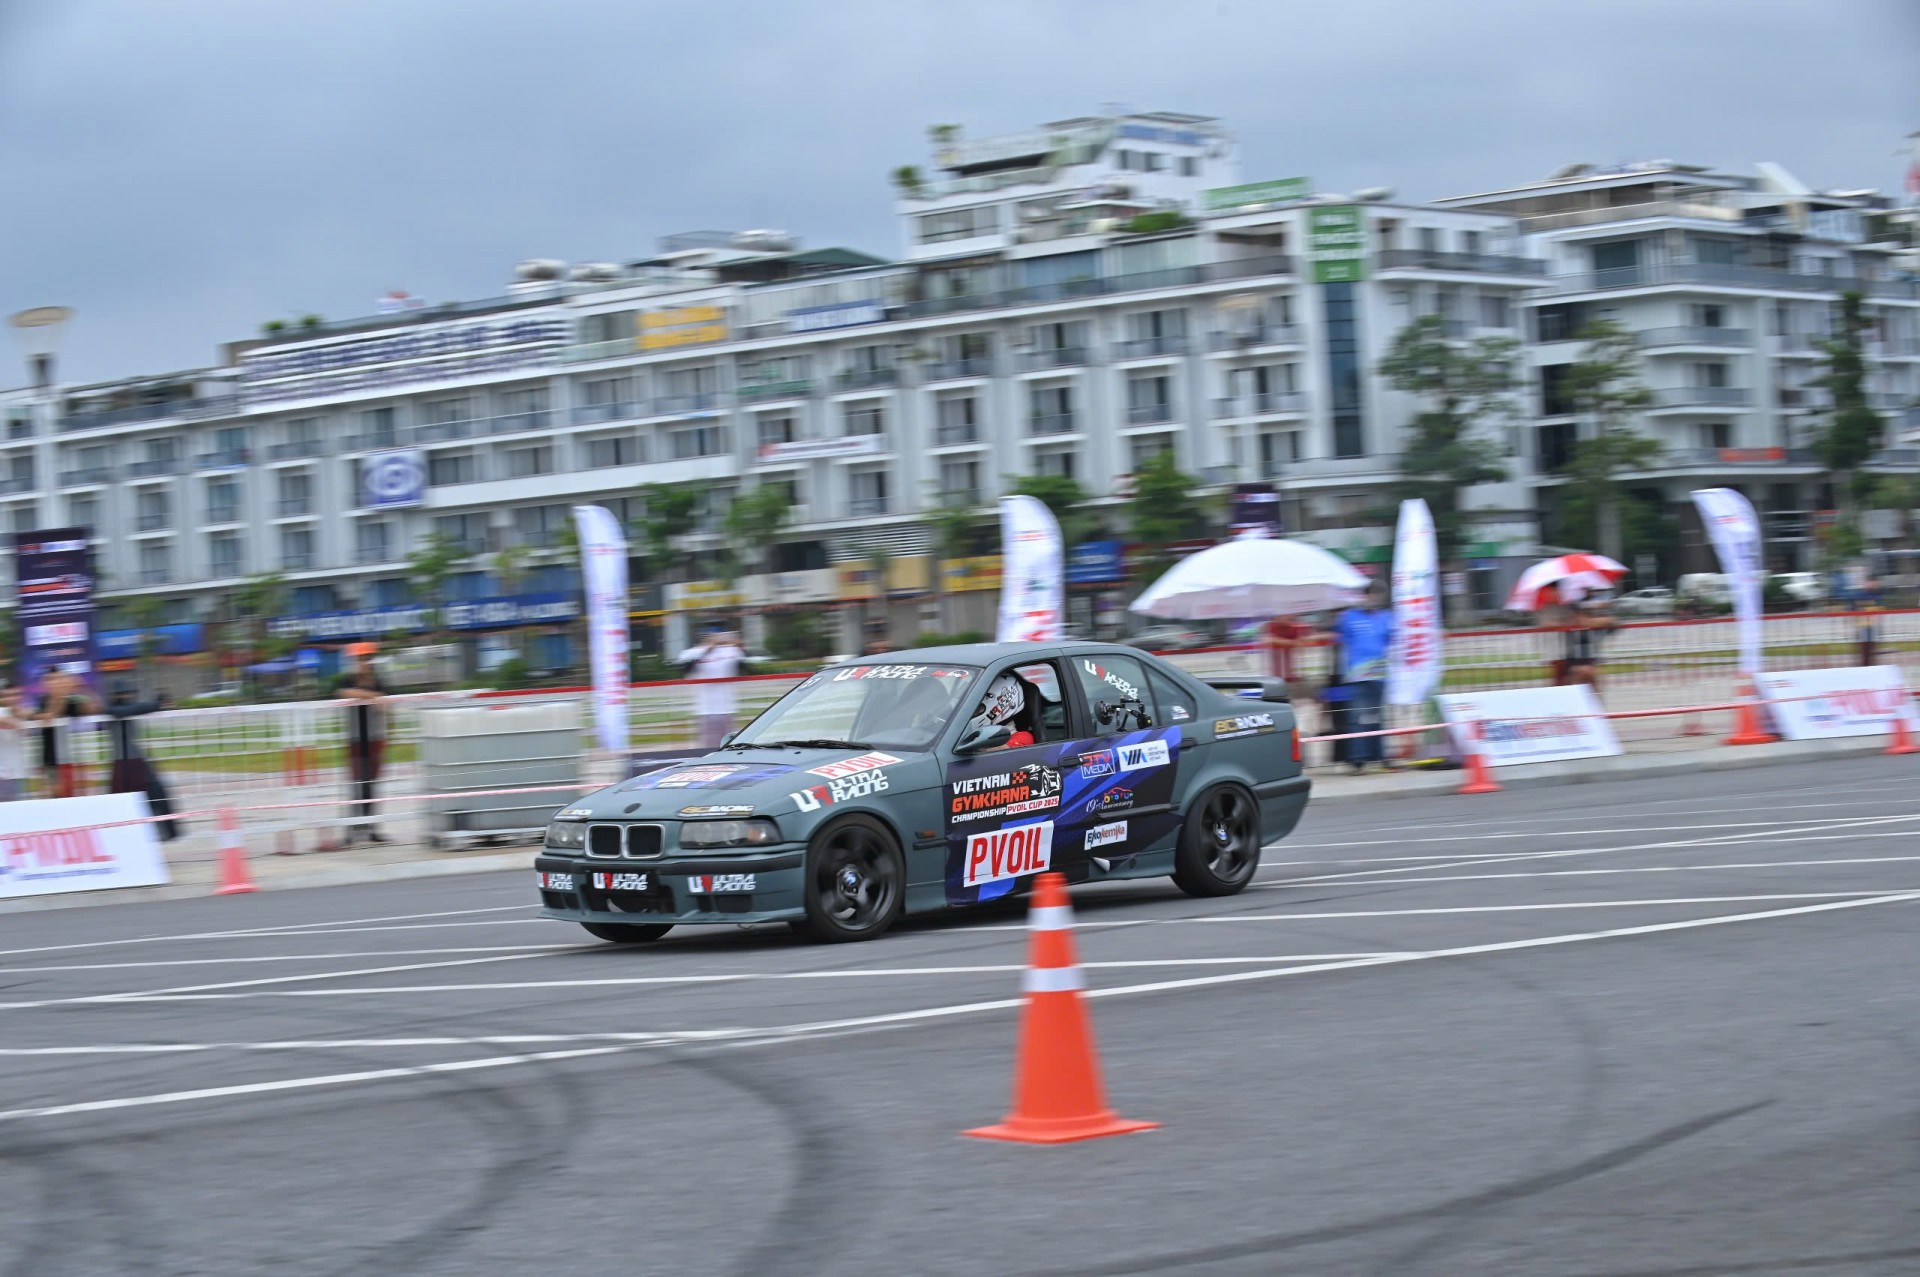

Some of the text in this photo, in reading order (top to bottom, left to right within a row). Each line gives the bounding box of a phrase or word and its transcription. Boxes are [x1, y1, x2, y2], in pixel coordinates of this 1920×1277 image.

[813, 755, 897, 777] PVOIL
[1083, 763, 1113, 776] MEDIA
[827, 769, 881, 791] ULTRA
[831, 776, 889, 803] RACING
[952, 773, 1011, 795] VIETNAM
[951, 785, 1031, 813] GYMKHANA
[951, 797, 1060, 824] CHAMPIONSHIP PVOIL CUP 2025
[969, 826, 1045, 882] PVOIL
